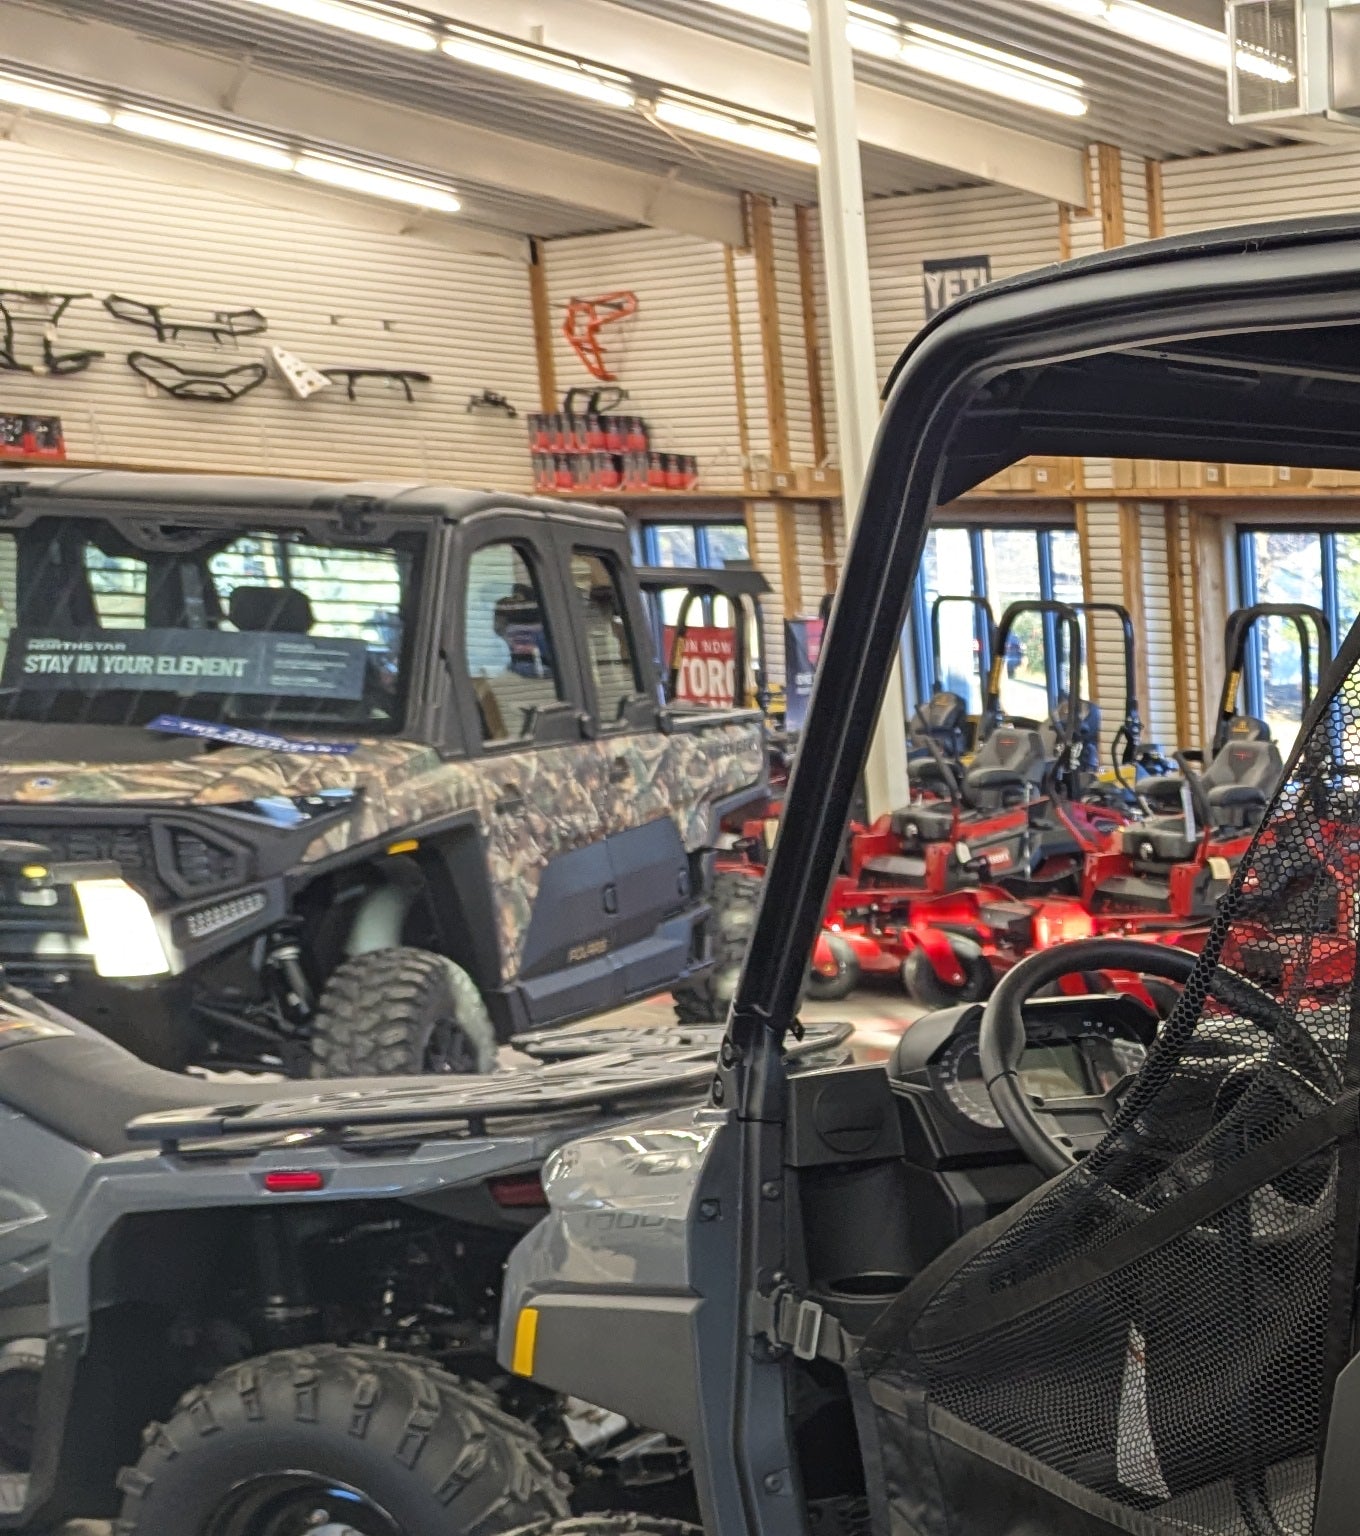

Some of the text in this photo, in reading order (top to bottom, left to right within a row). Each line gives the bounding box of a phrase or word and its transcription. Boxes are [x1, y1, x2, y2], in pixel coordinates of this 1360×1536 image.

[24, 655, 73, 675] STAY
[76, 655, 99, 675] IN
[102, 655, 152, 676] YOUR
[156, 657, 249, 678] ELEMENT
